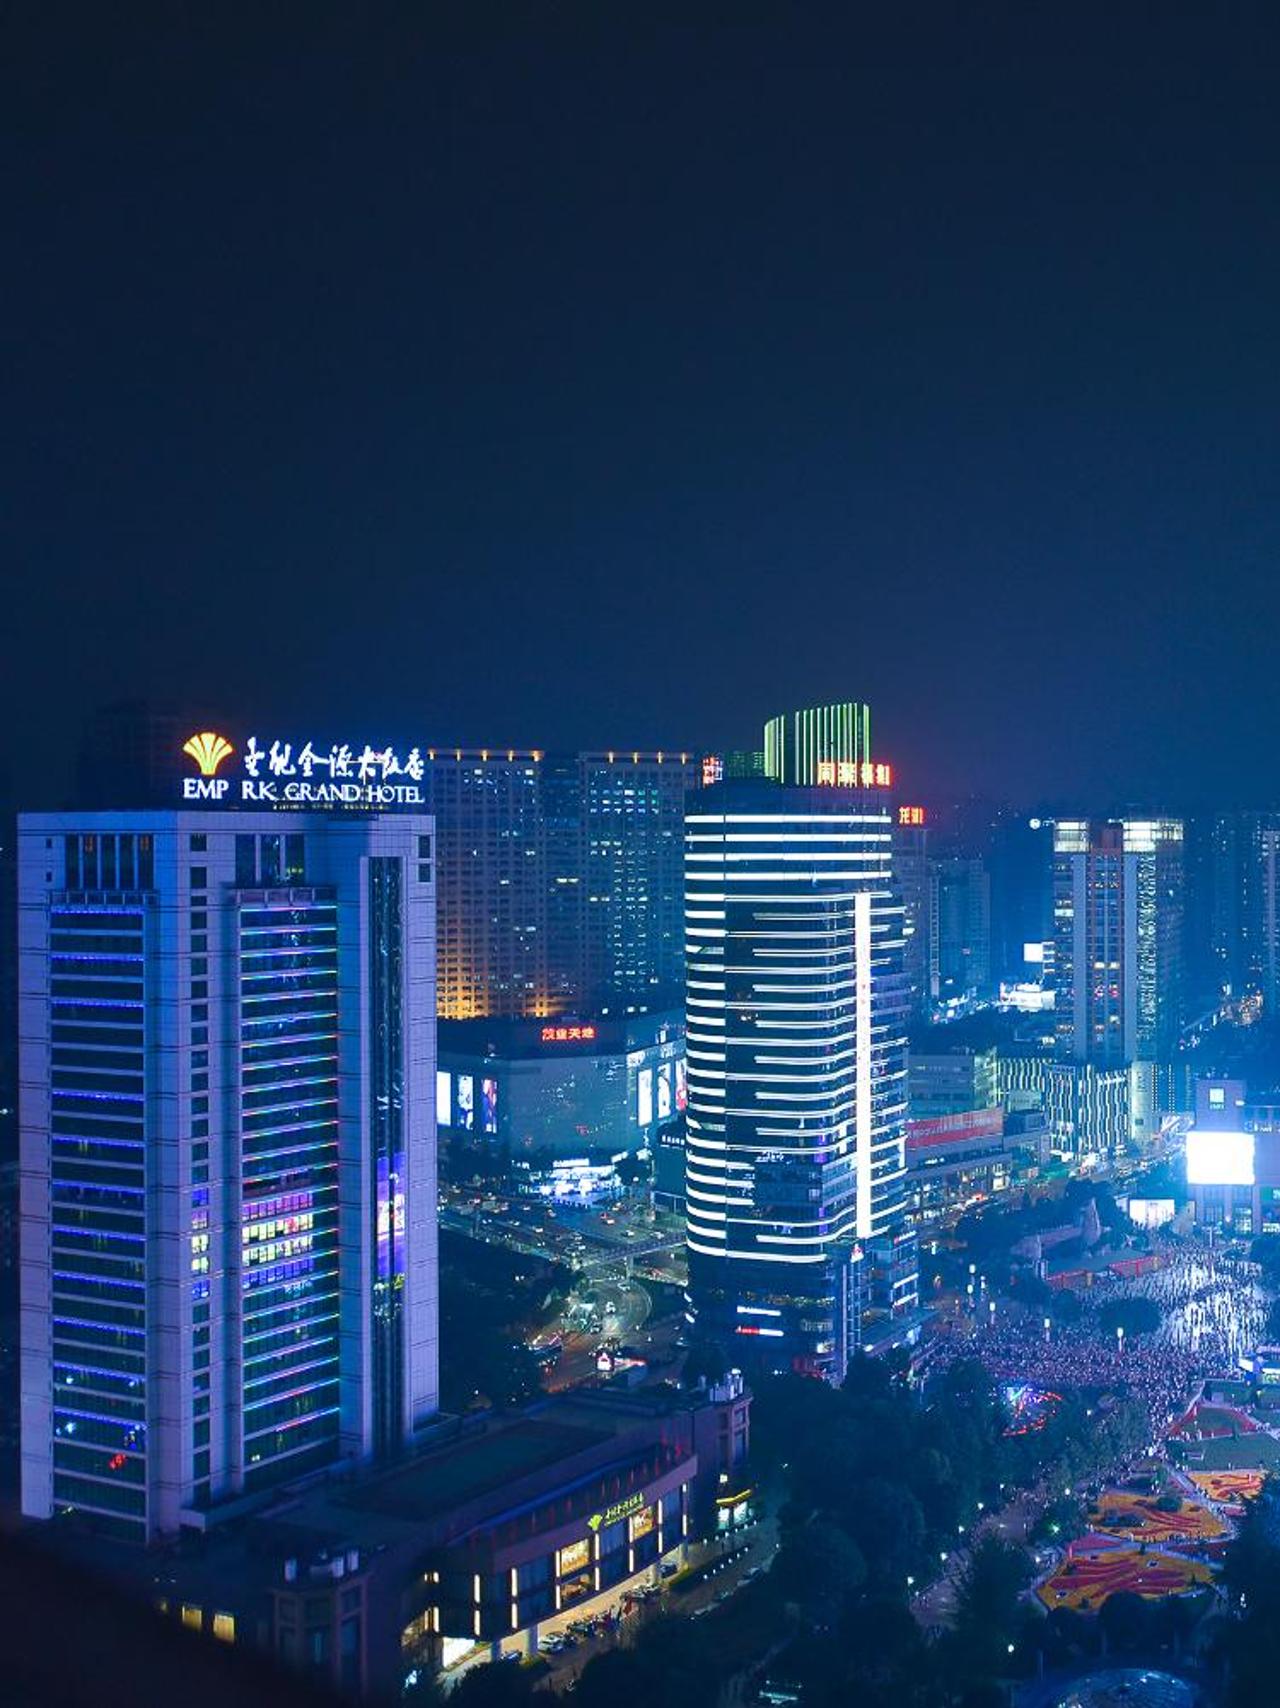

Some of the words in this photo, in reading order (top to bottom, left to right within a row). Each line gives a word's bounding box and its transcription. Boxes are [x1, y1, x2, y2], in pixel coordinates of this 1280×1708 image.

[182, 778, 278, 801] EMPRK
[284, 781, 362, 802] GRAND
[368, 783, 425, 803] HOTEL
